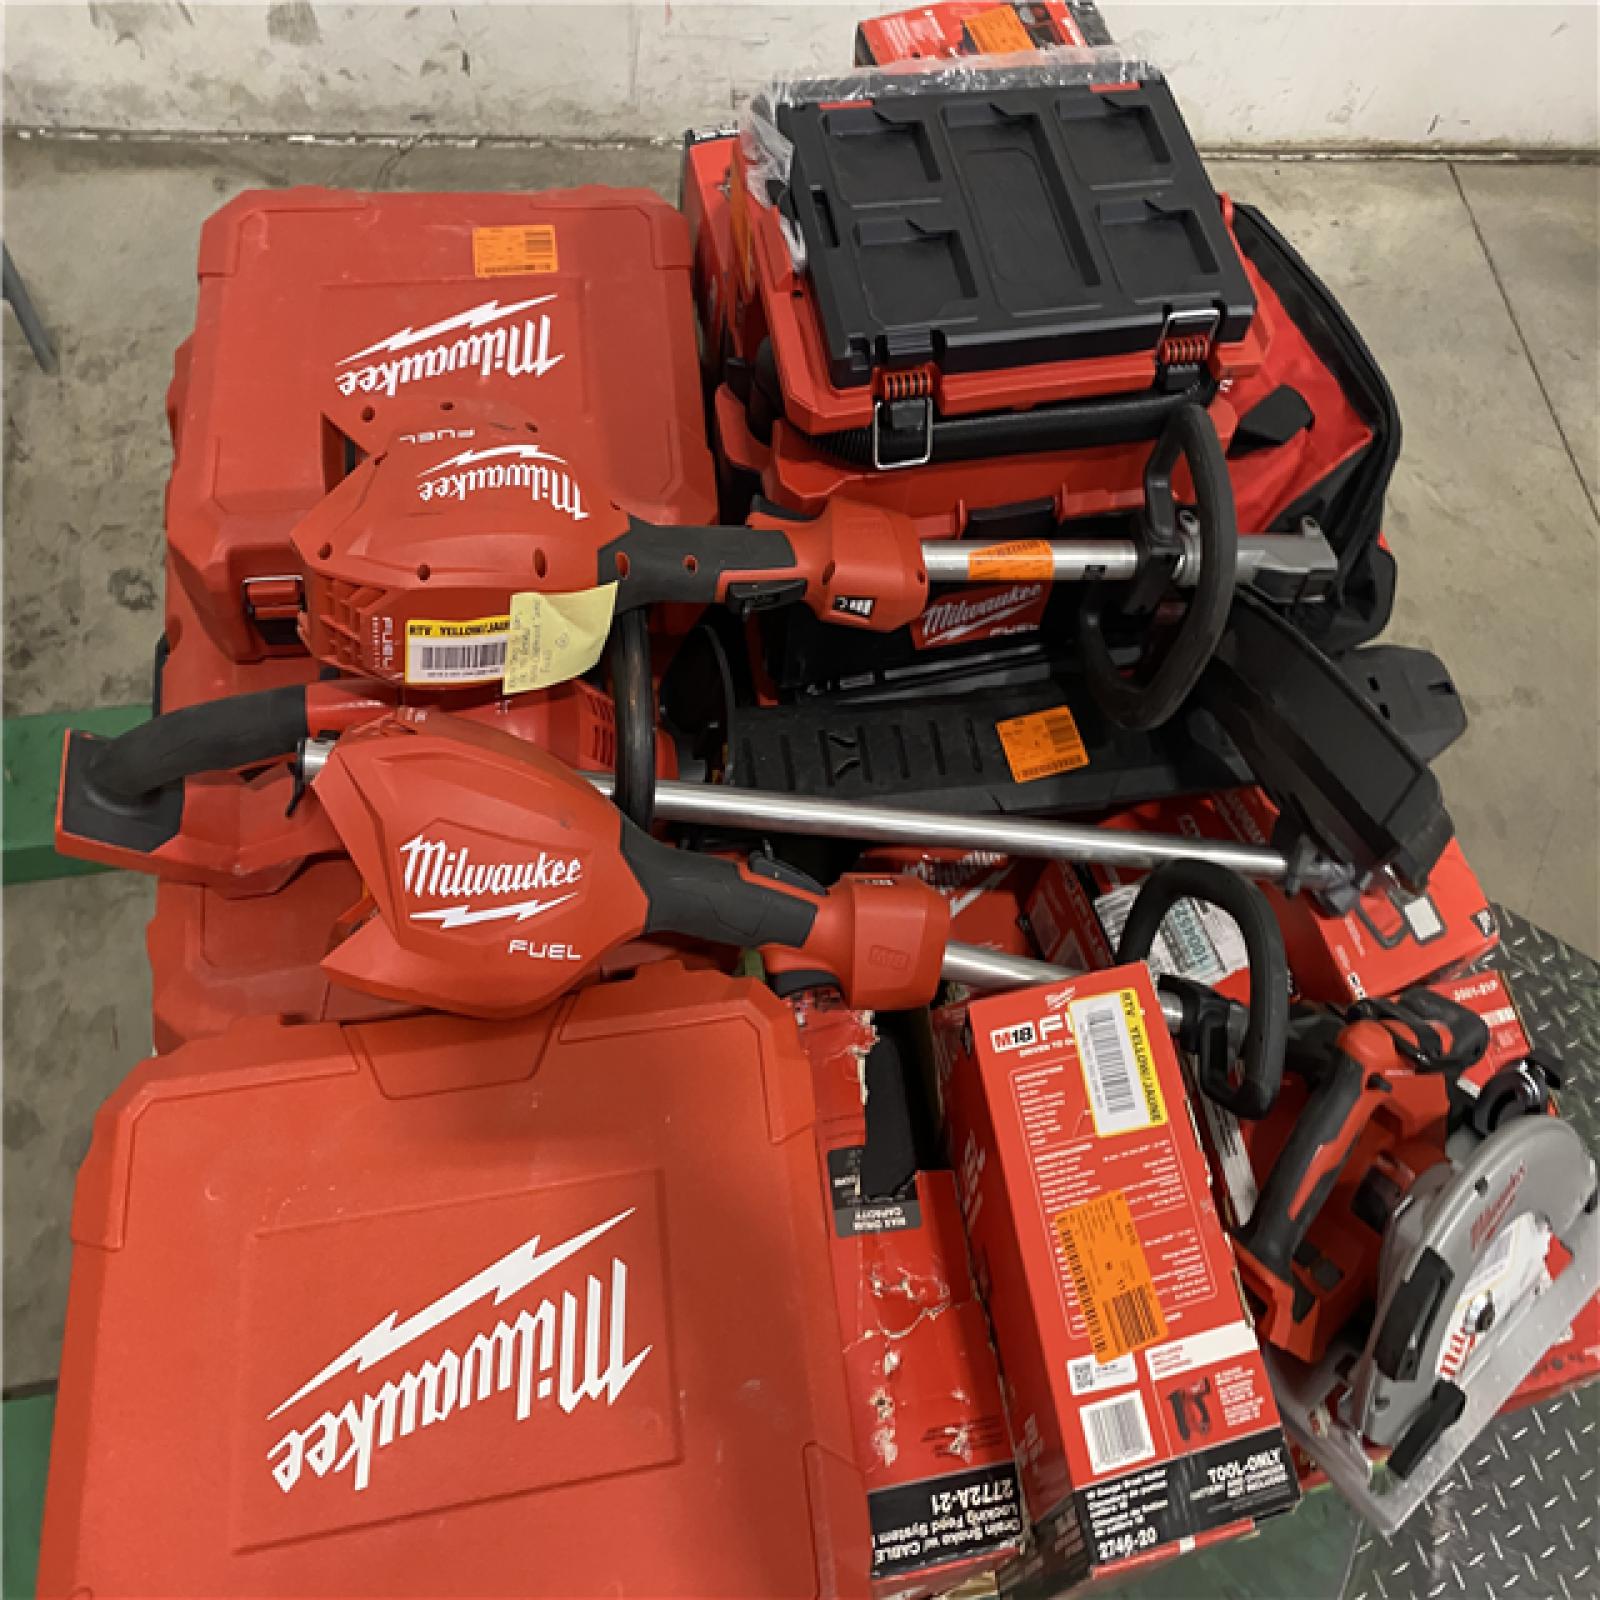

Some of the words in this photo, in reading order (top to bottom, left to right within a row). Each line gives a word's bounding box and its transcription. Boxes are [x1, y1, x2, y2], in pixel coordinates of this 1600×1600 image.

[335, 315, 565, 396] Milwaukee
[400, 429, 475, 444] FUEL
[417, 464, 590, 520] Milwaukee
[923, 584, 1041, 637] Milwaukee
[400, 835, 583, 898] Milwaukee
[508, 940, 582, 960] FUEL
[993, 1023, 1035, 1050] M18
[267, 1256, 653, 1493] Milwaukee
[1207, 1448, 1281, 1484] TOOL-ONLY
[931, 1479, 1014, 1515] 2772A-21
